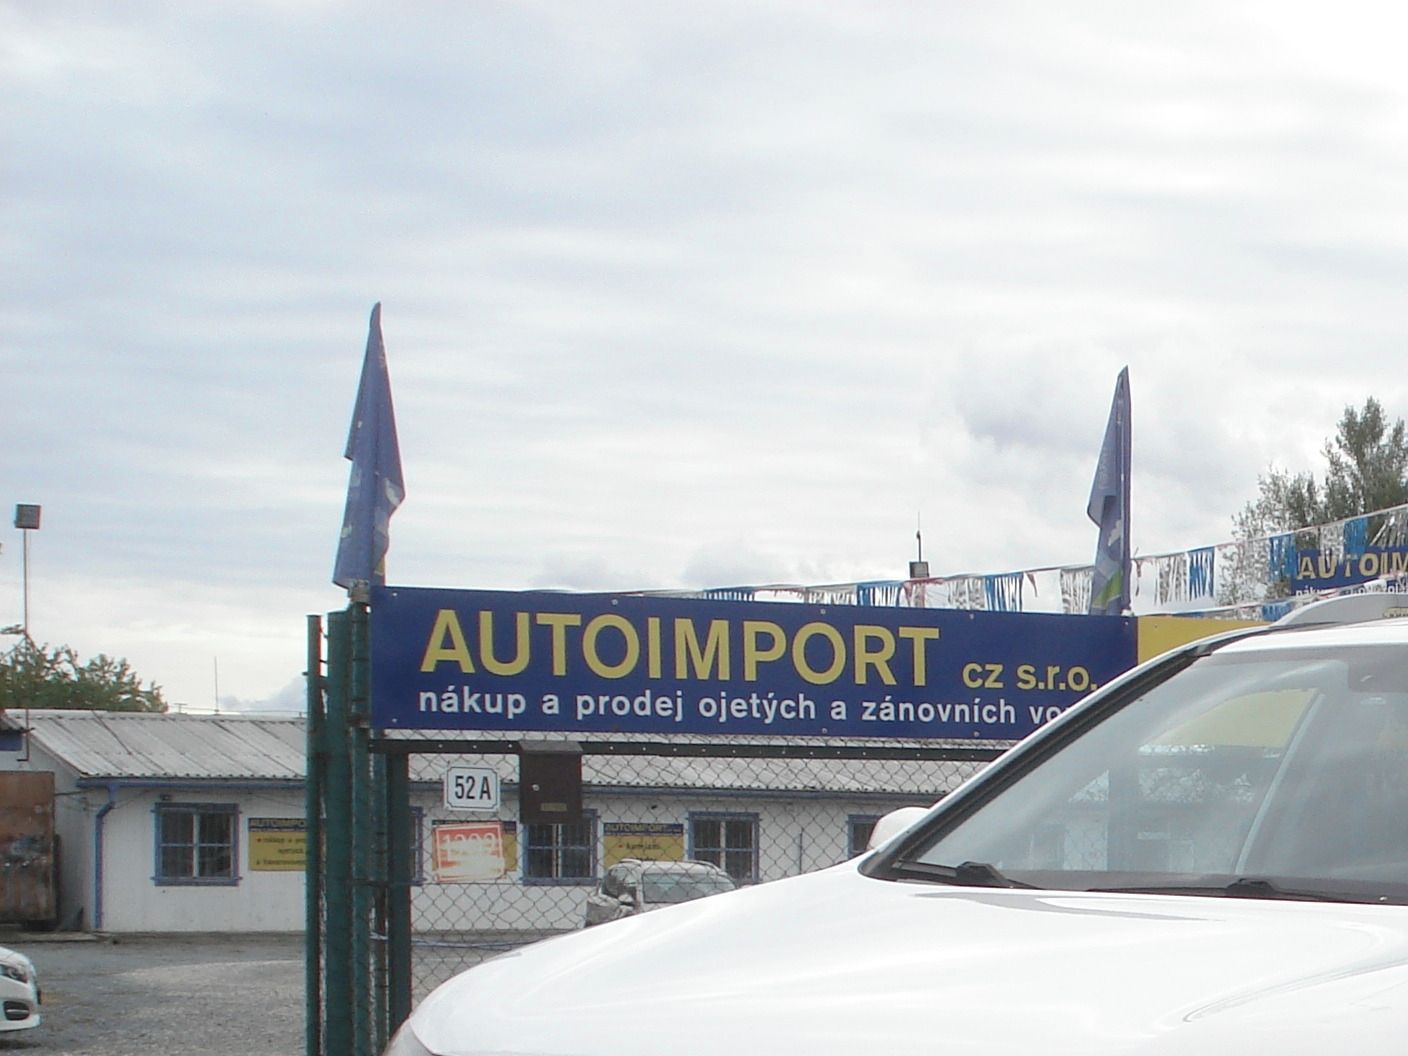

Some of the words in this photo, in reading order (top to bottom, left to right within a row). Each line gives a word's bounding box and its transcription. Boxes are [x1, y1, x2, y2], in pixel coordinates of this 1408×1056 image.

[420, 608, 939, 687] AUTOIMPORT
[962, 662, 1004, 689] cz
[1016, 664, 1098, 692] s.r.o.
[418, 685, 526, 719] nákup
[541, 693, 560, 715] a
[576, 689, 684, 722] prodej
[698, 691, 816, 724] ojetých
[830, 700, 847, 720] a
[861, 695, 1016, 725] zánovních
[1028, 704, 1070, 725] vo
[454, 775, 476, 800] 52
